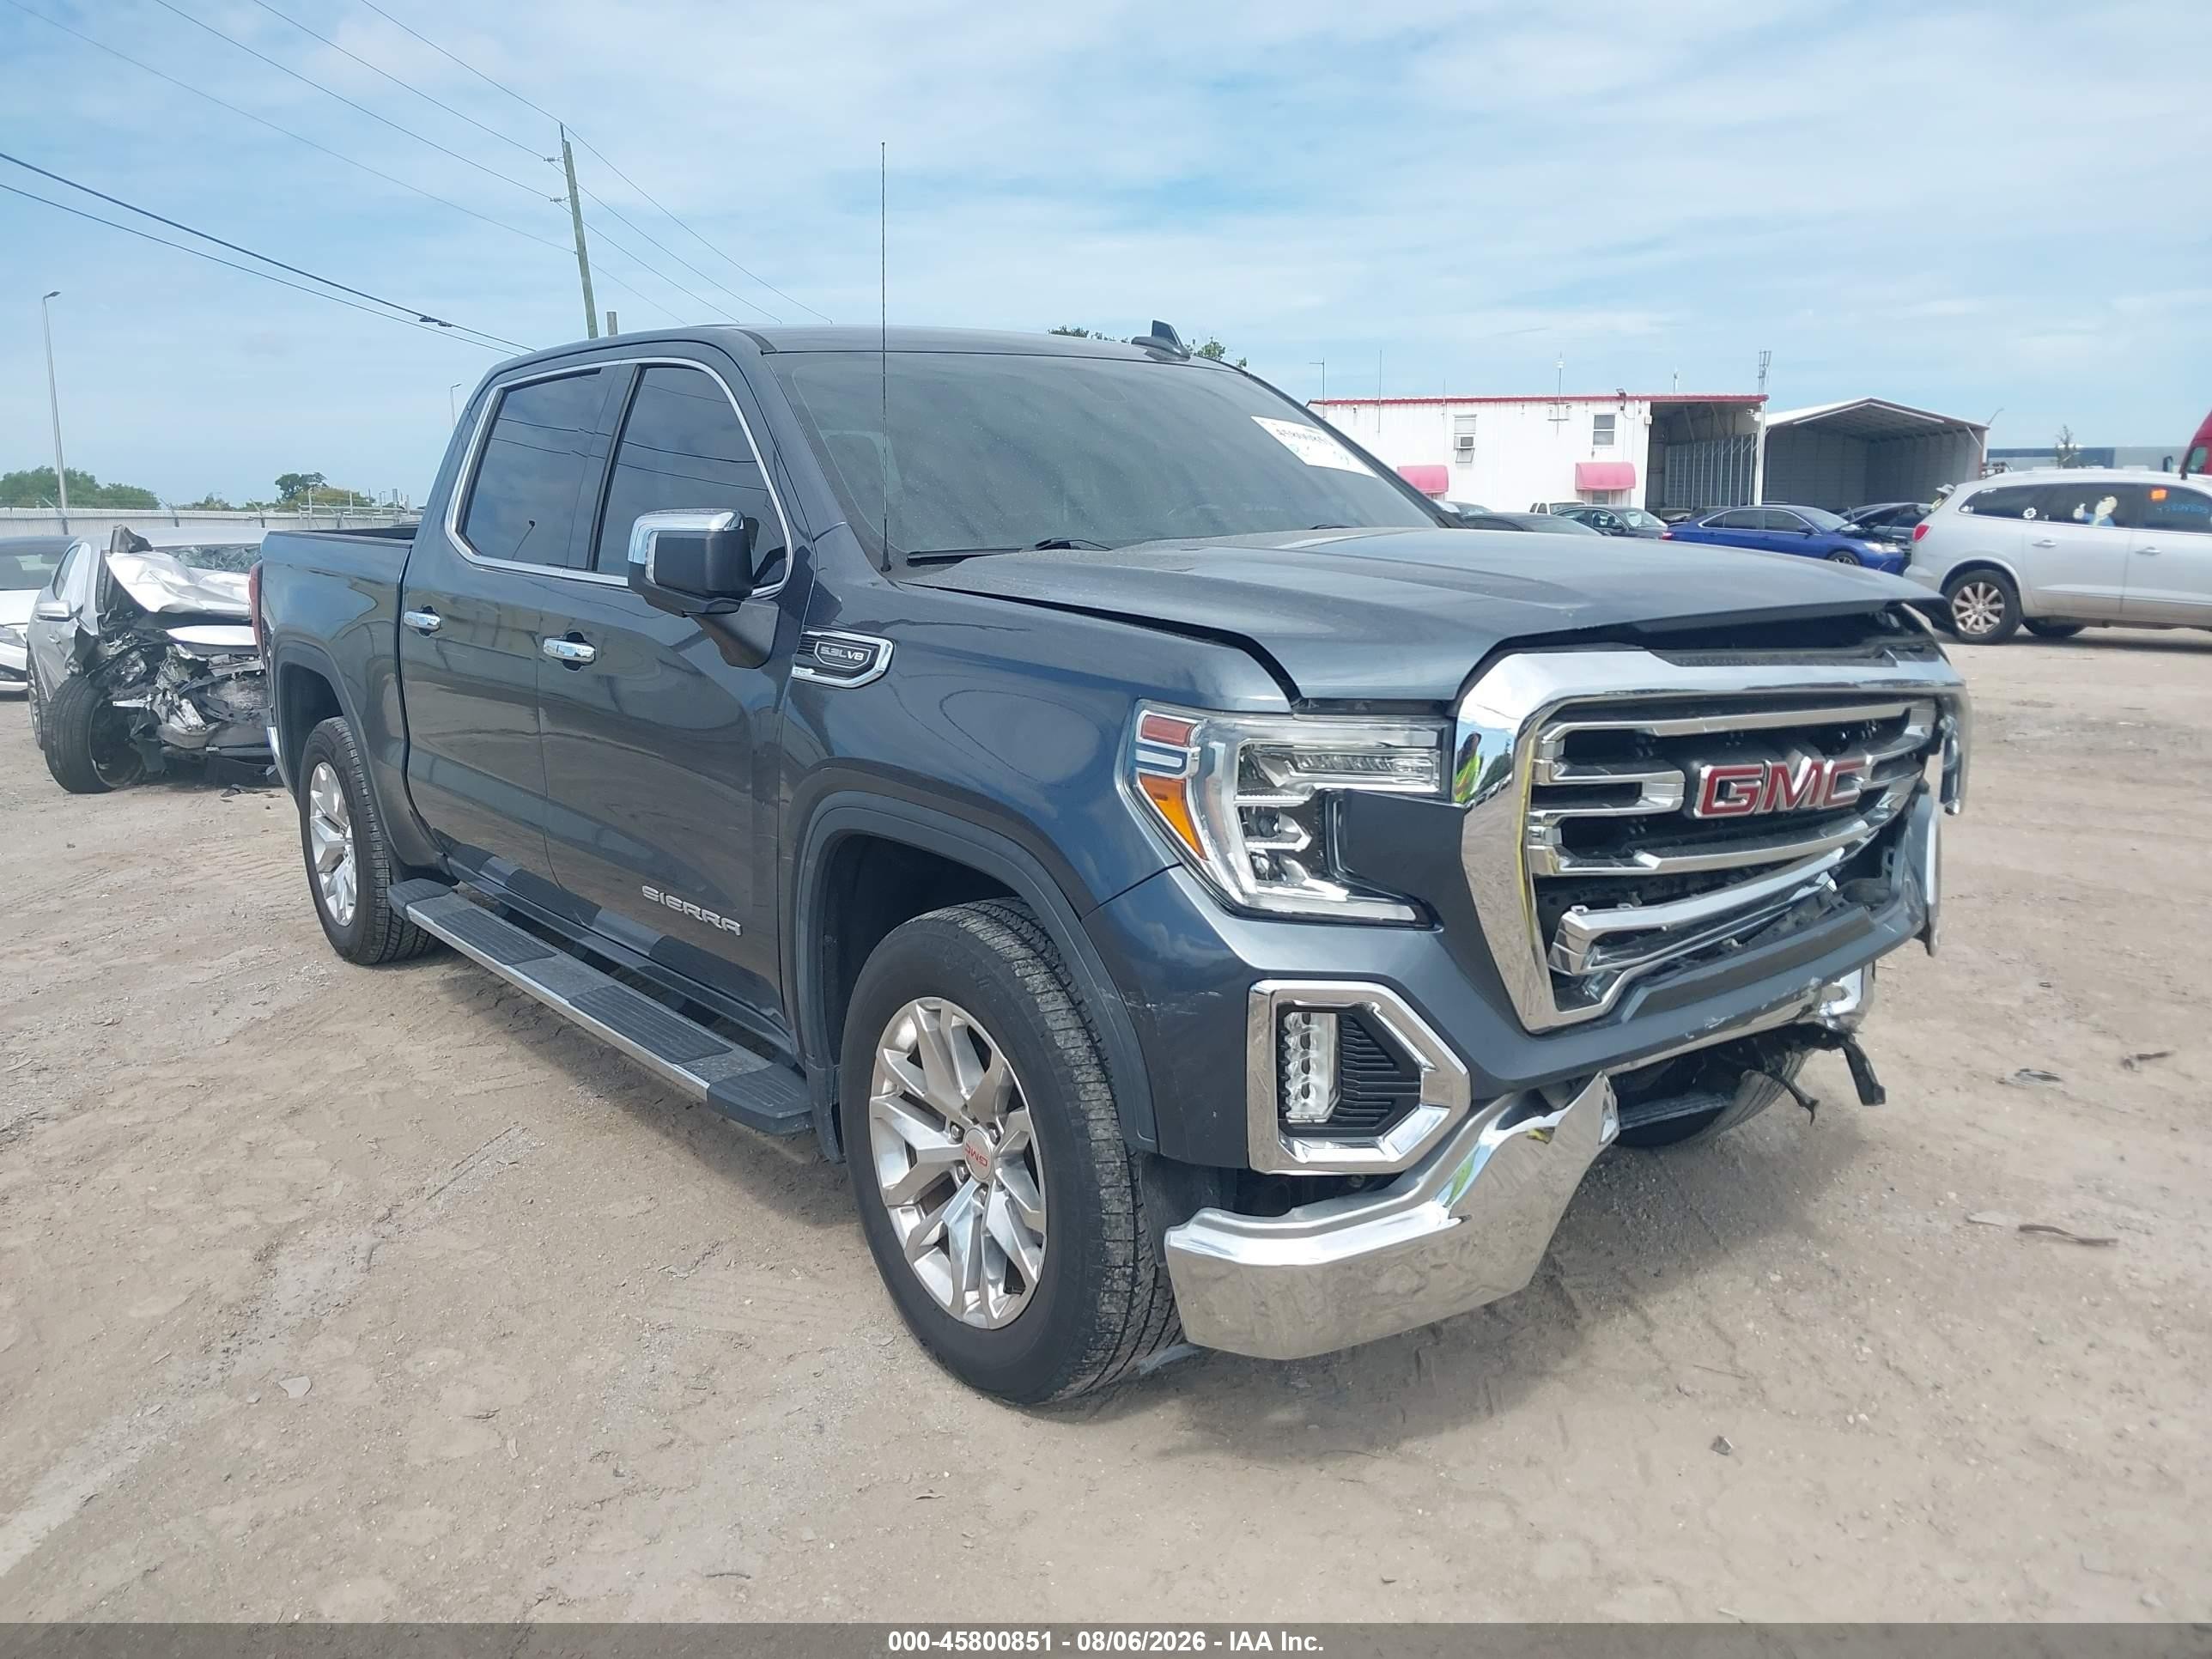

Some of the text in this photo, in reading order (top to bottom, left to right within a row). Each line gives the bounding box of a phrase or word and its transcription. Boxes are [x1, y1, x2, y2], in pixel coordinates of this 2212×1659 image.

[1693, 757, 1869, 817] GMC
[641, 885, 743, 936] SIERRA
[964, 1143, 988, 1167] GMC
